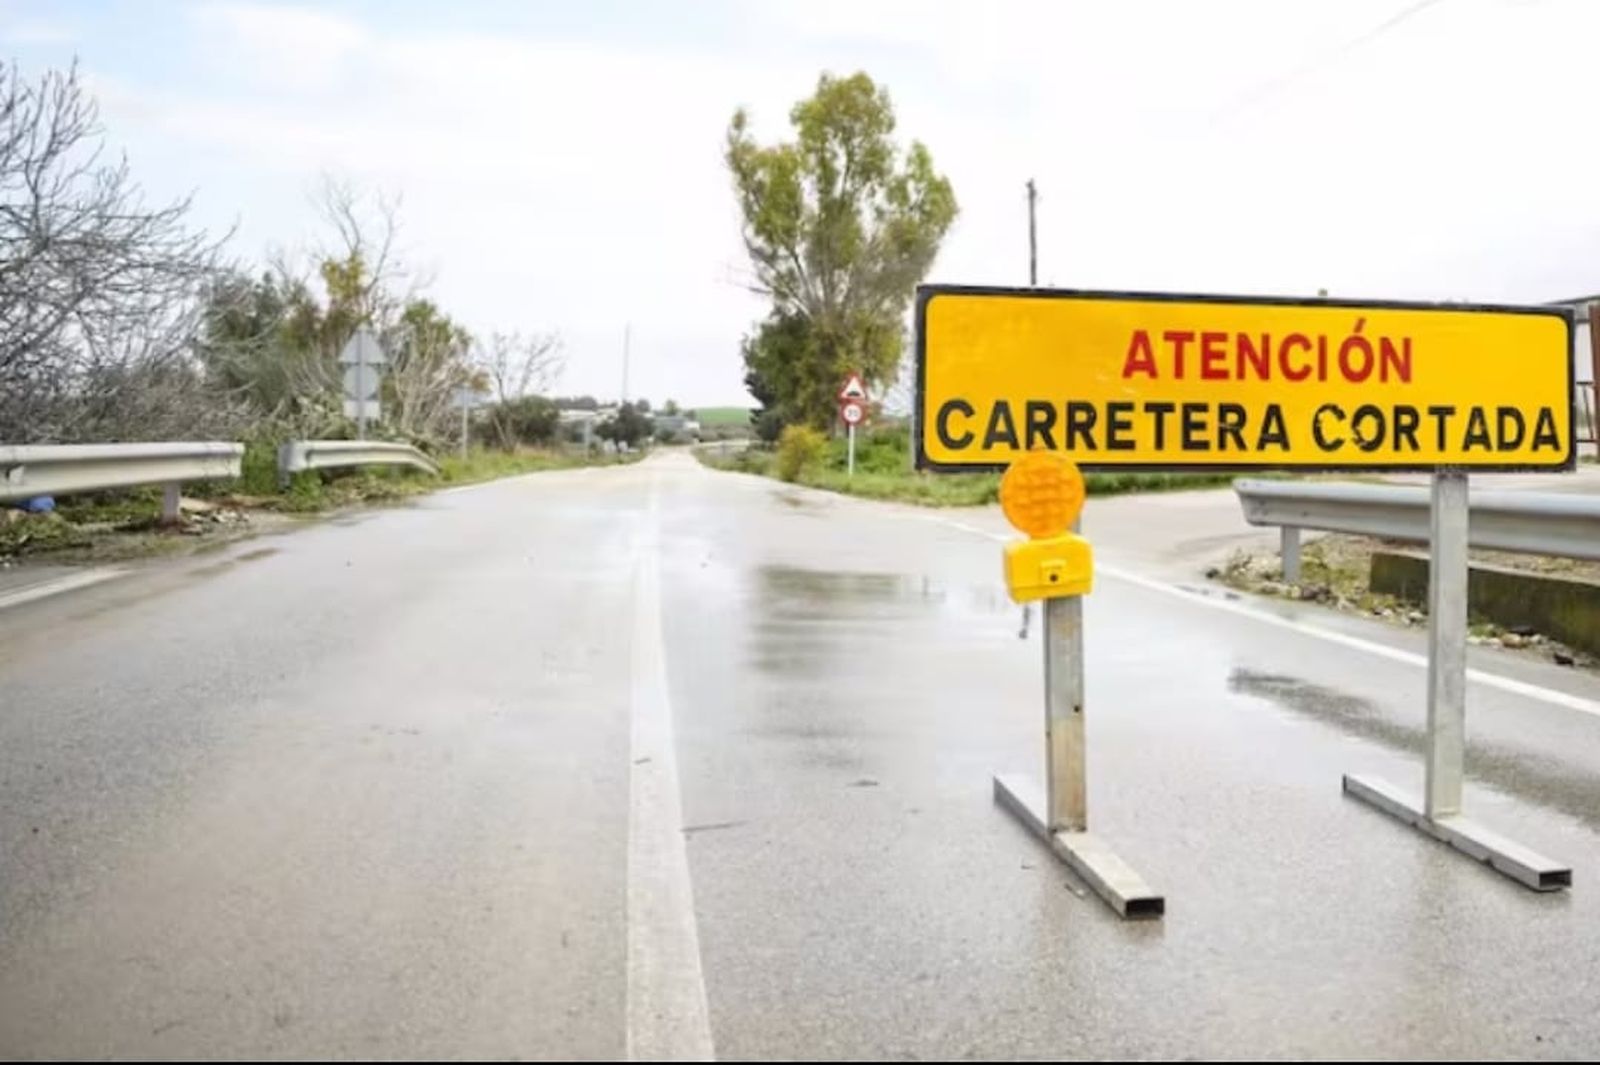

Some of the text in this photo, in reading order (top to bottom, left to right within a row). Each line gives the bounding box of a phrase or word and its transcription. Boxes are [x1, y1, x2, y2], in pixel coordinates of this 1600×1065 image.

[1122, 318, 1413, 384] ATENCIÓN
[936, 399, 1562, 453] CARRETERA CORTADA
